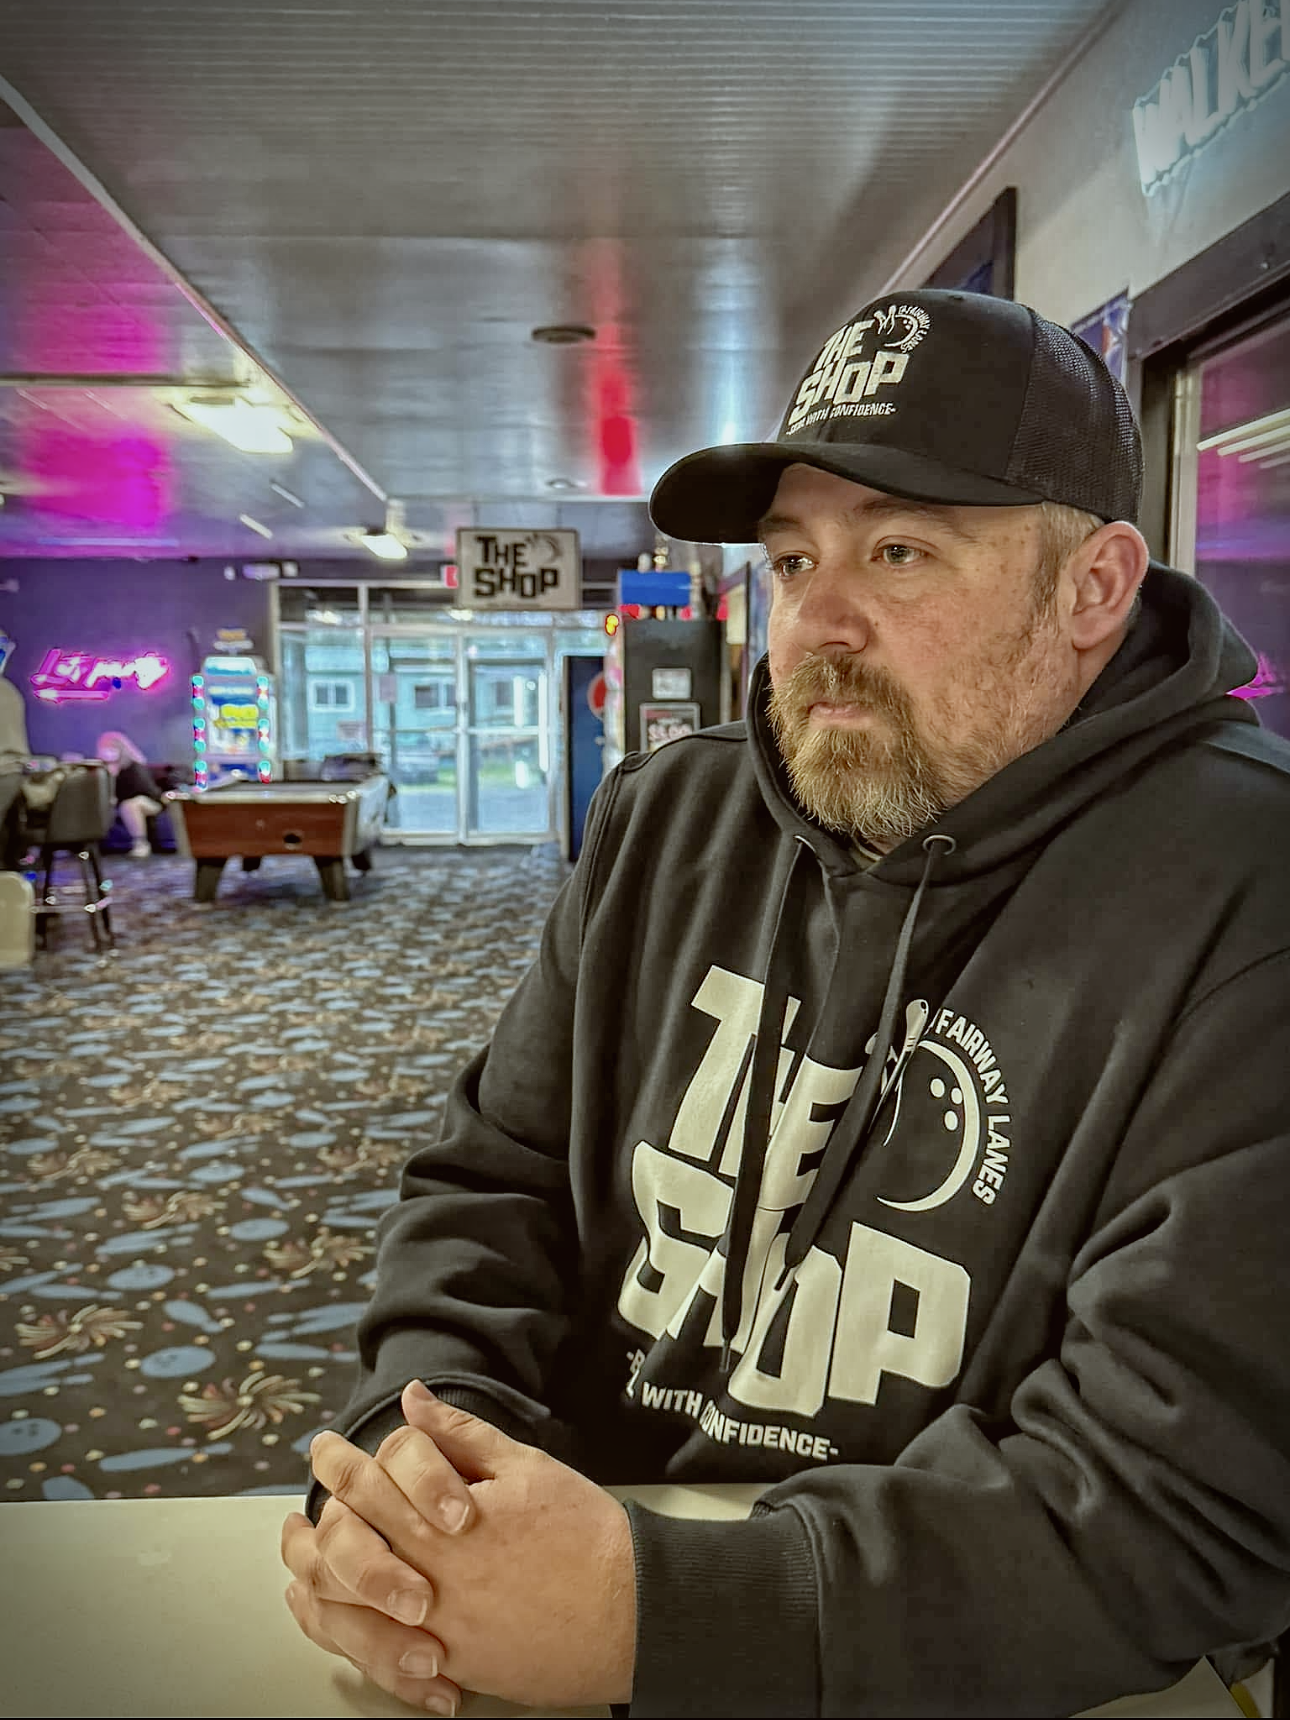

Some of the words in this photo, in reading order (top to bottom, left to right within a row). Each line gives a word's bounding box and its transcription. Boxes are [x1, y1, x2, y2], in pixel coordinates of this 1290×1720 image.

[813, 319, 875, 374] THE
[788, 351, 909, 426] SHOP
[474, 535, 526, 567] THE
[474, 567, 559, 599] SHOP
[972, 1115, 1011, 1205] LANES
[617, 1140, 971, 1418] SHOP
[641, 1381, 703, 1420] WITH
